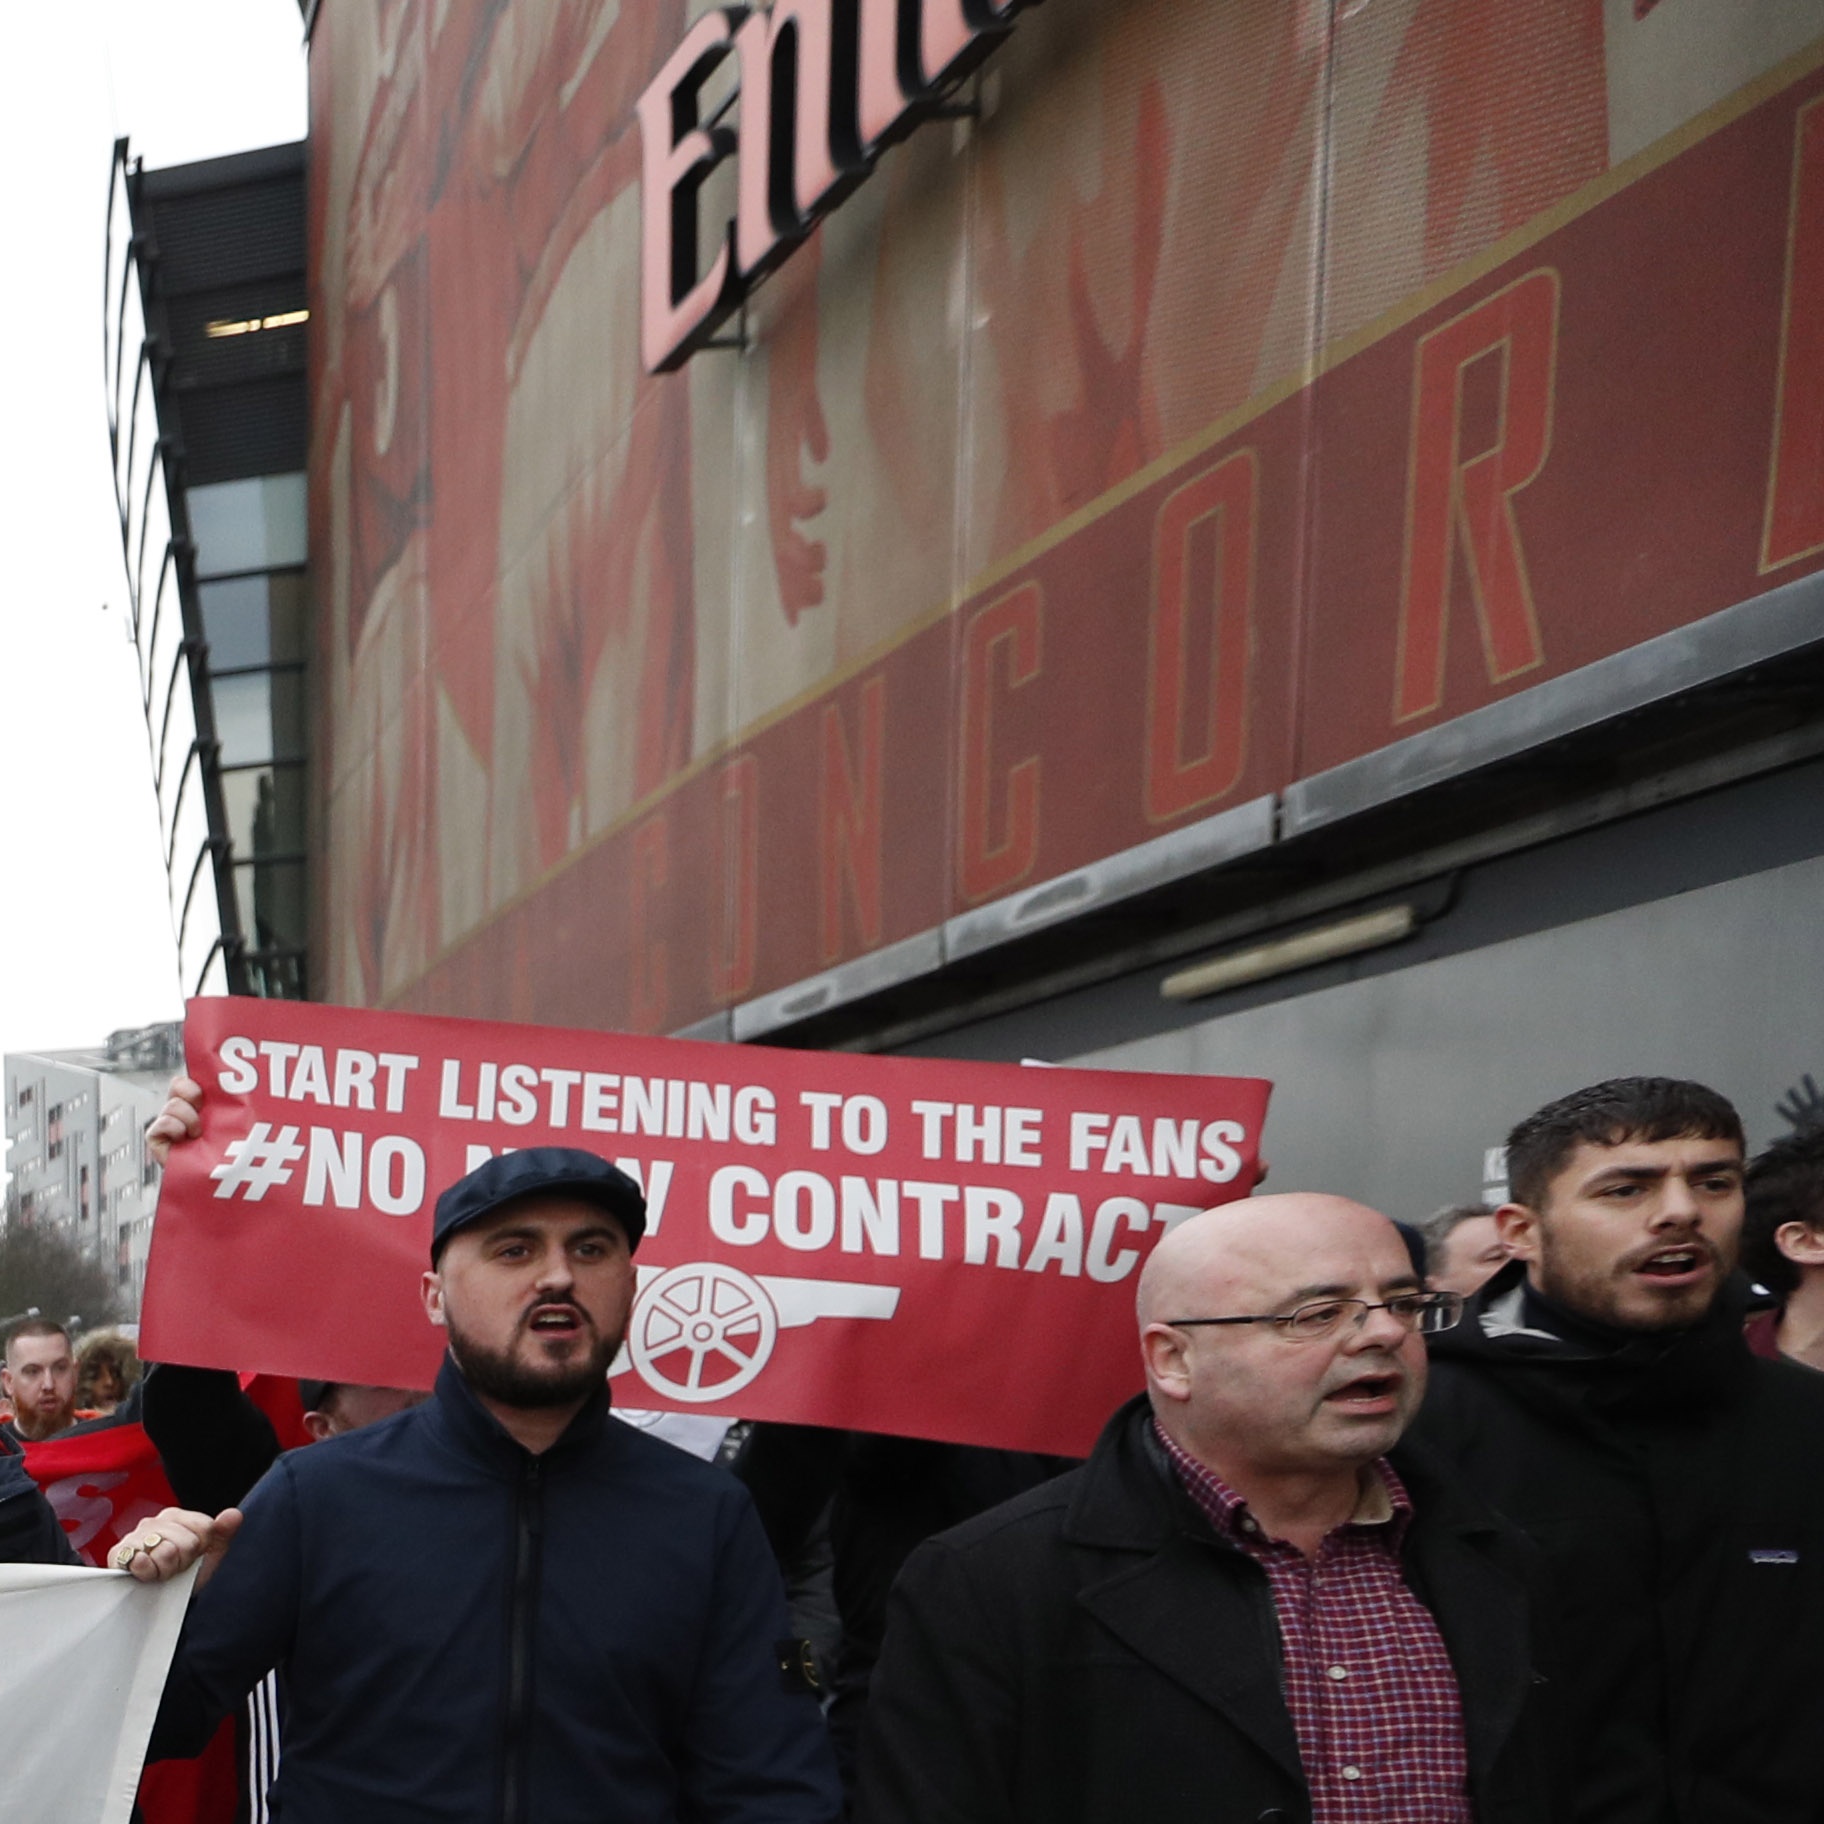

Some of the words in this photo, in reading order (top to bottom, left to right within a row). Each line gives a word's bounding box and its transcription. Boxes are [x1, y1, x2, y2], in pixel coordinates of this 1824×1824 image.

[209, 1121, 427, 1217] #NO
[217, 1035, 419, 1114] START
[438, 1057, 775, 1147] LISTENING
[799, 1091, 888, 1156] TO
[911, 1099, 1043, 1169] THE
[1069, 1113, 1246, 1184] FANS
